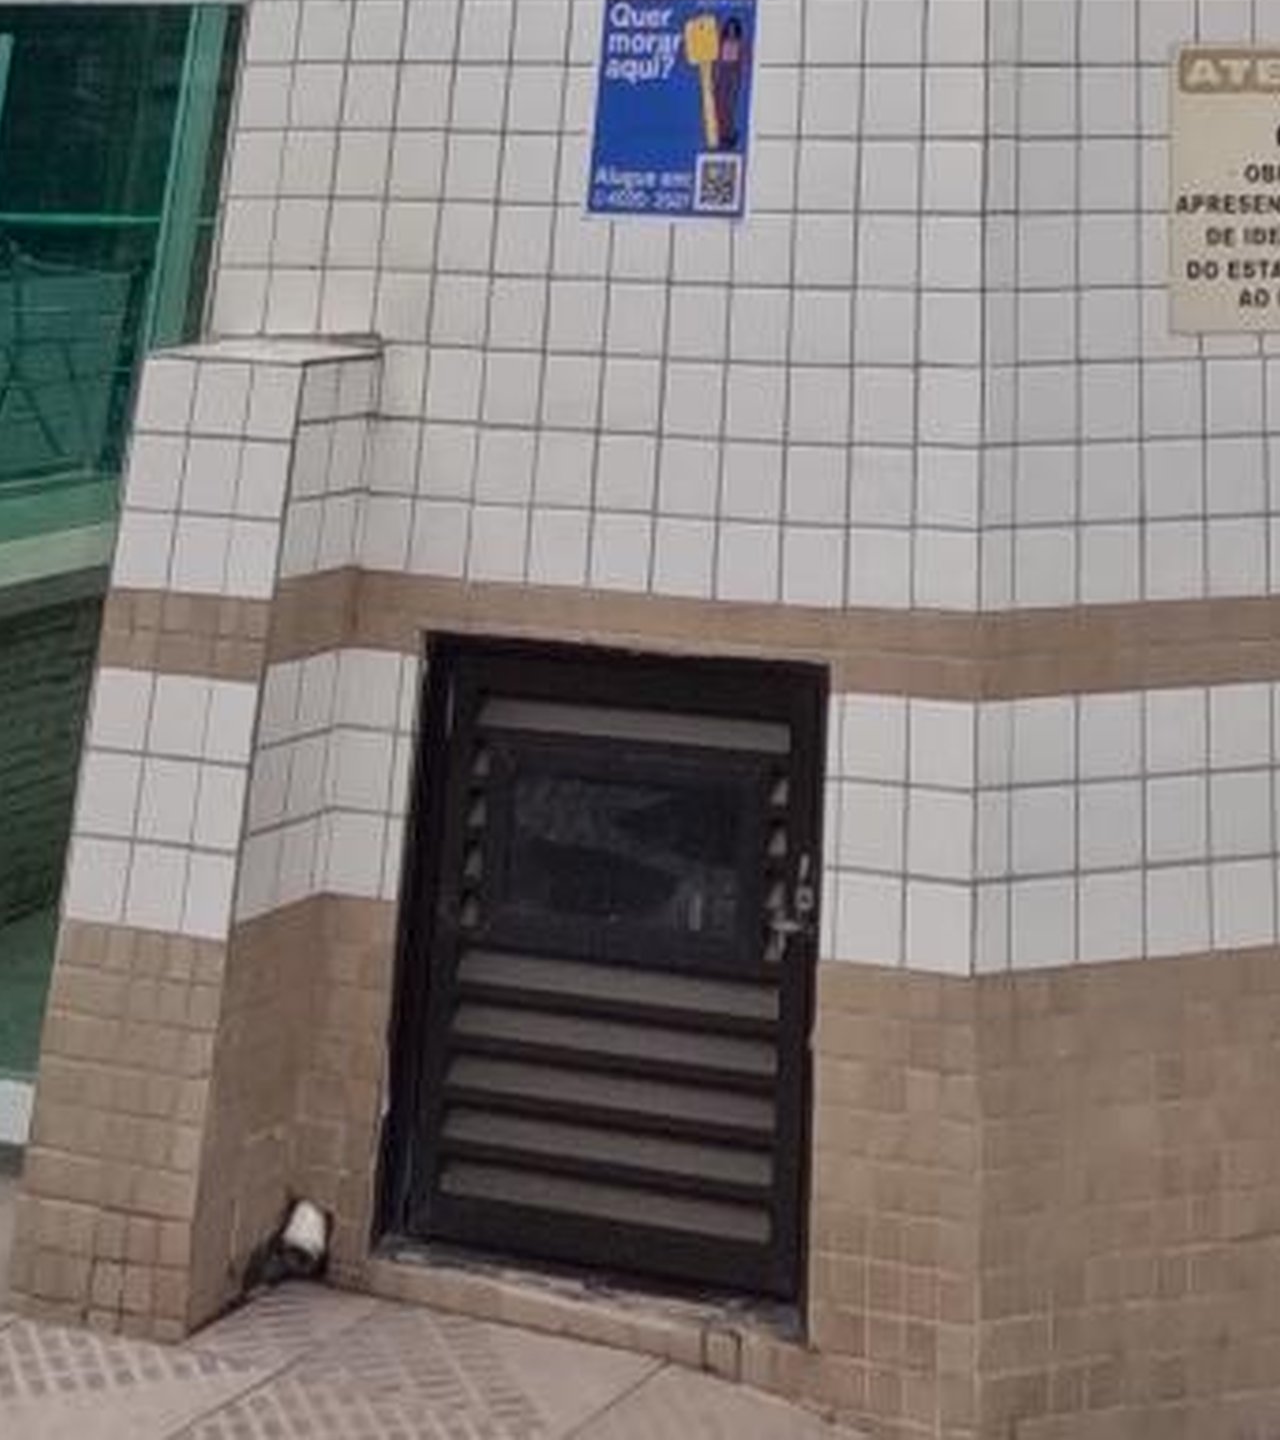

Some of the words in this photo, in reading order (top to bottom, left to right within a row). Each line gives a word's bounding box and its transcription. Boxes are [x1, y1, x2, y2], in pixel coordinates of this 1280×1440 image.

[609, 2, 672, 28] Quer
[608, 33, 682, 54] morar
[605, 56, 675, 84] aqui?
[1205, 227, 1235, 247] DE
[1185, 259, 1219, 280] DO
[1238, 288, 1271, 308] AO
